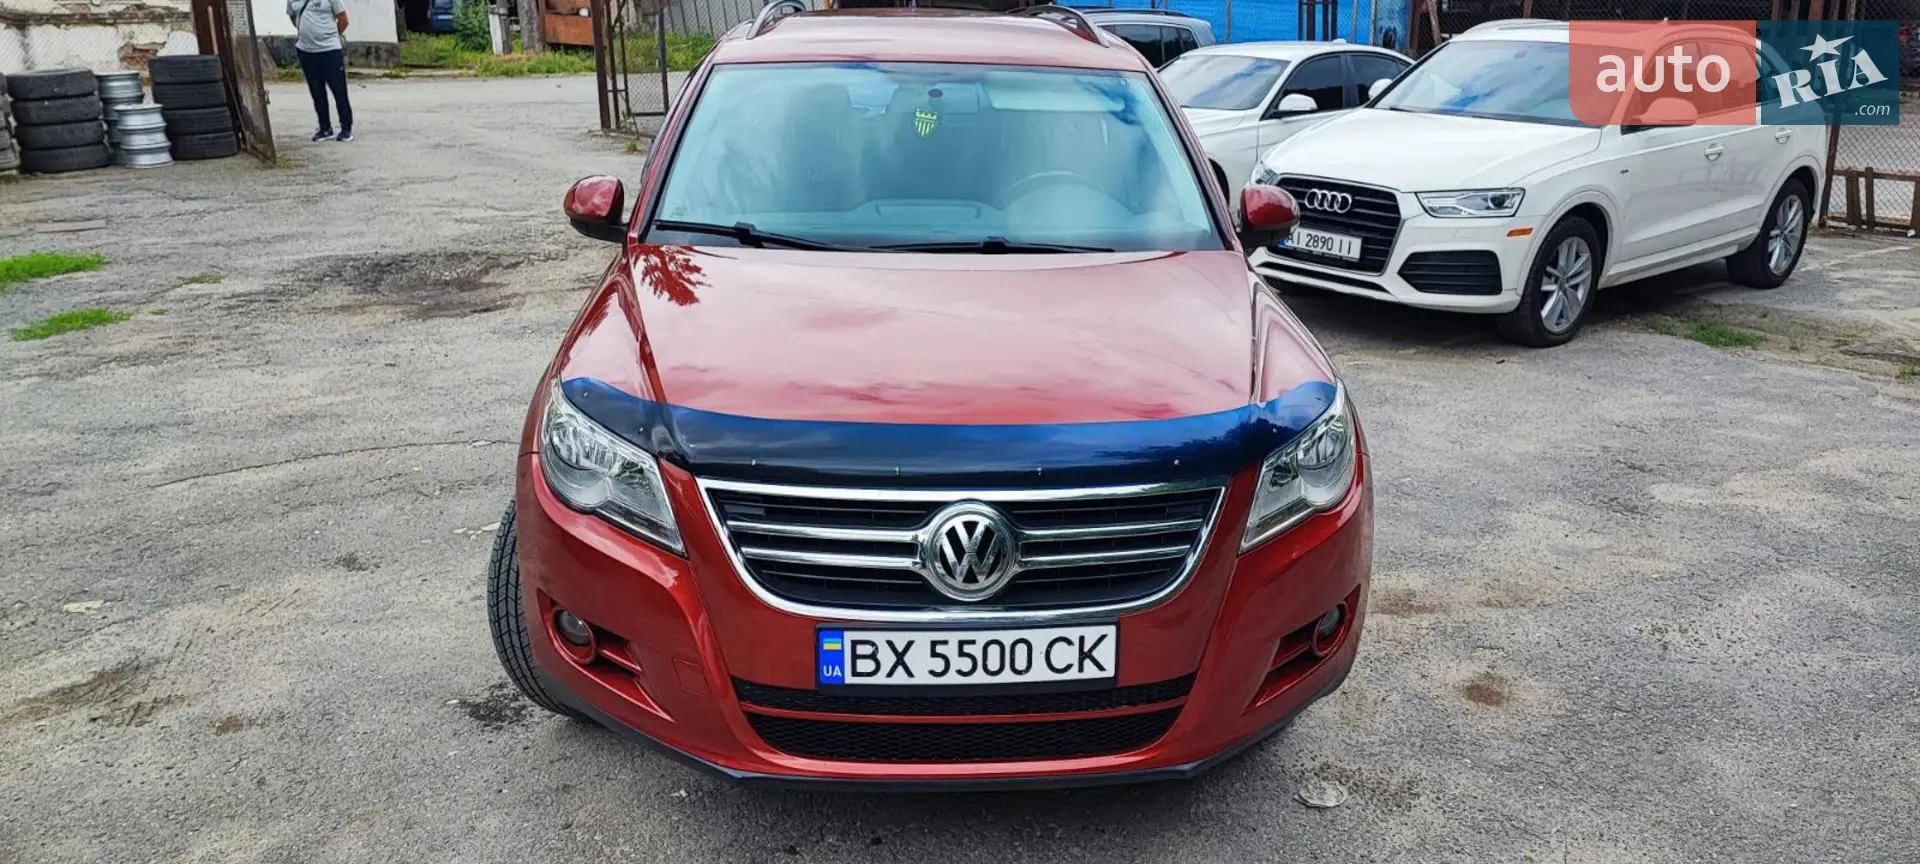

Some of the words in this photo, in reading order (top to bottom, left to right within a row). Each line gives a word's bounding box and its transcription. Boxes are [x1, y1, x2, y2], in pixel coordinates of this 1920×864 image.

[1305, 233, 1334, 251] 2890
[850, 639, 915, 678] BX
[928, 637, 1033, 677] 5500
[1044, 634, 1108, 674] CK
[823, 665, 842, 677] UA
